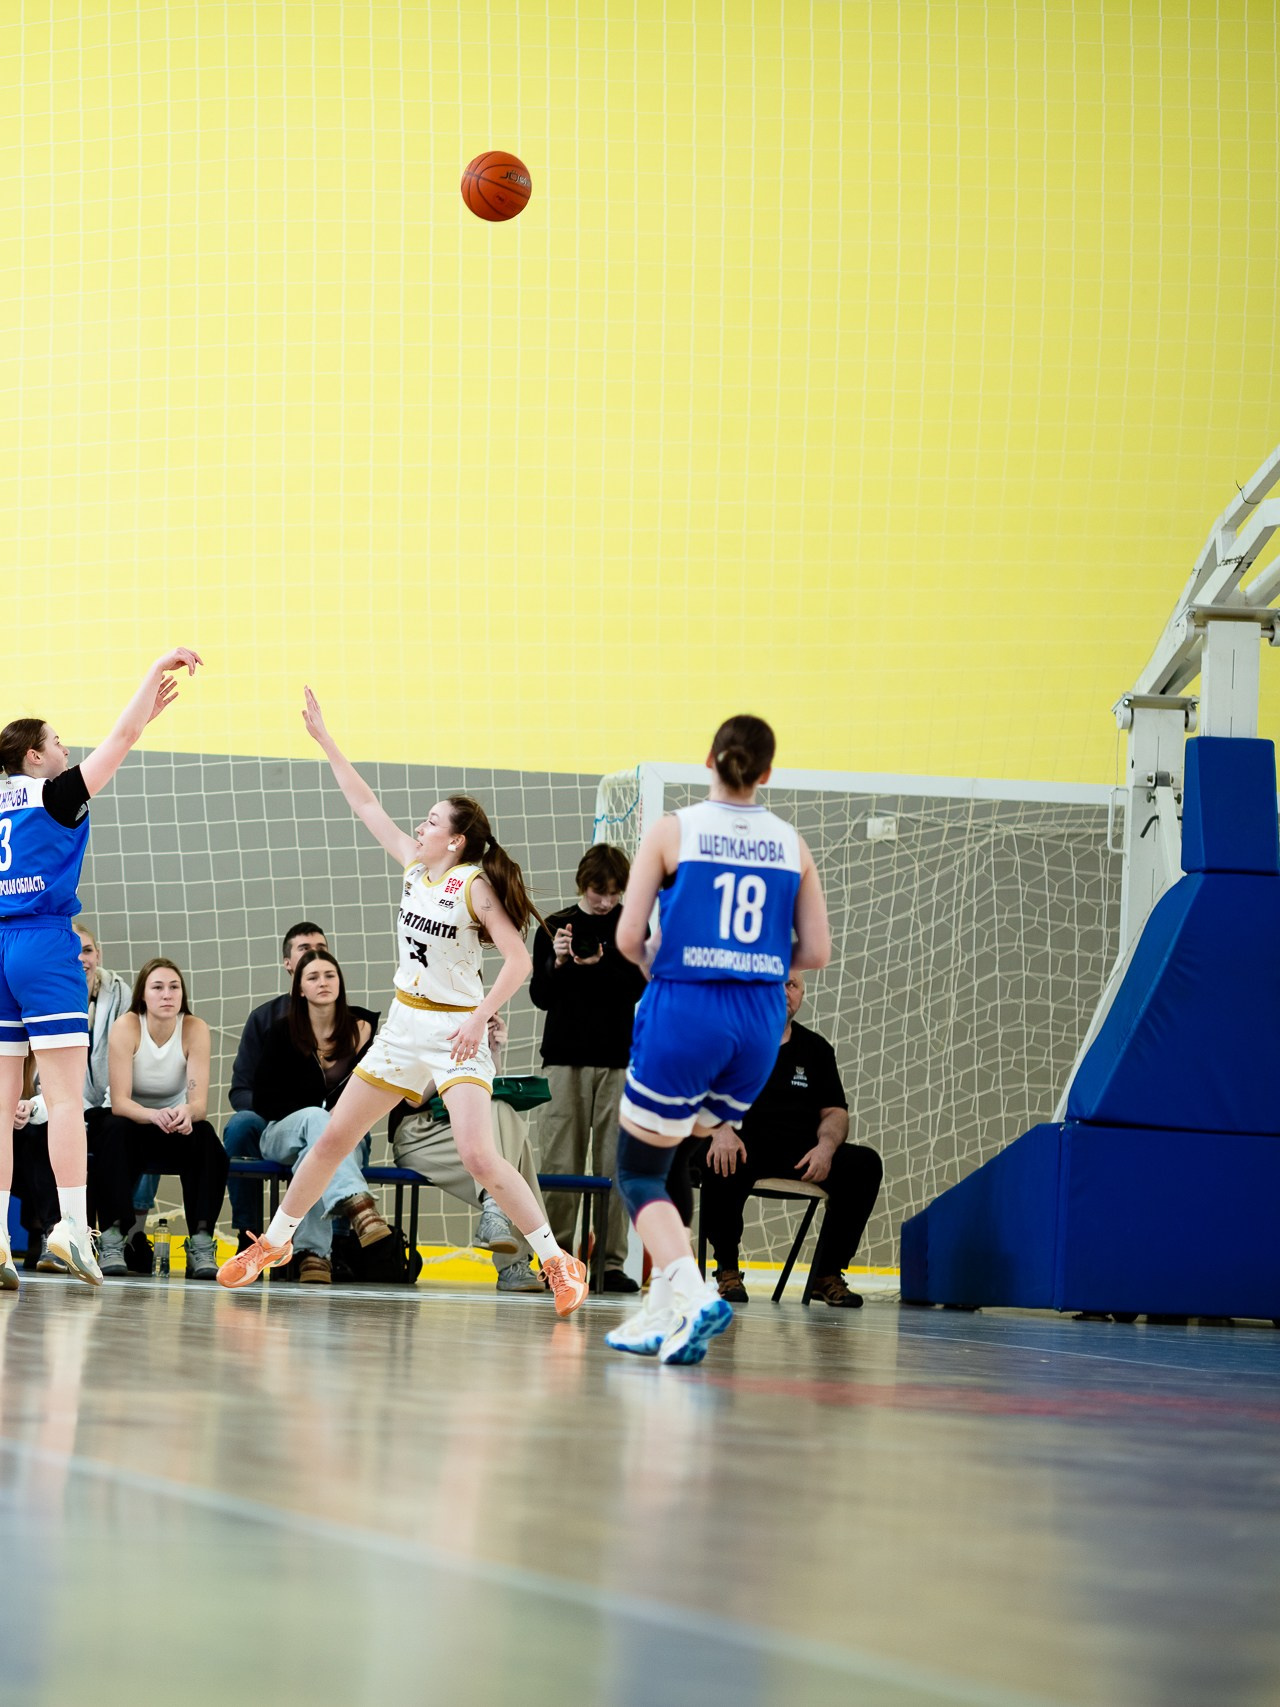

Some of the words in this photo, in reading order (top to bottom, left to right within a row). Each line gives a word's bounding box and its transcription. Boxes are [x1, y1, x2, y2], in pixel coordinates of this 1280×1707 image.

[699, 833, 786, 863] ЩЕЛКАНОВА
[16, 876, 46, 894] ОБЛАСТЬ
[445, 886, 459, 894] BET
[448, 878, 463, 888] FON
[713, 871, 767, 944] 18
[399, 907, 458, 940] -АТЛАНТА
[682, 946, 752, 973] НОВОСИБИРСКАЯ
[752, 953, 785, 977] ОБЛАСТЬ
